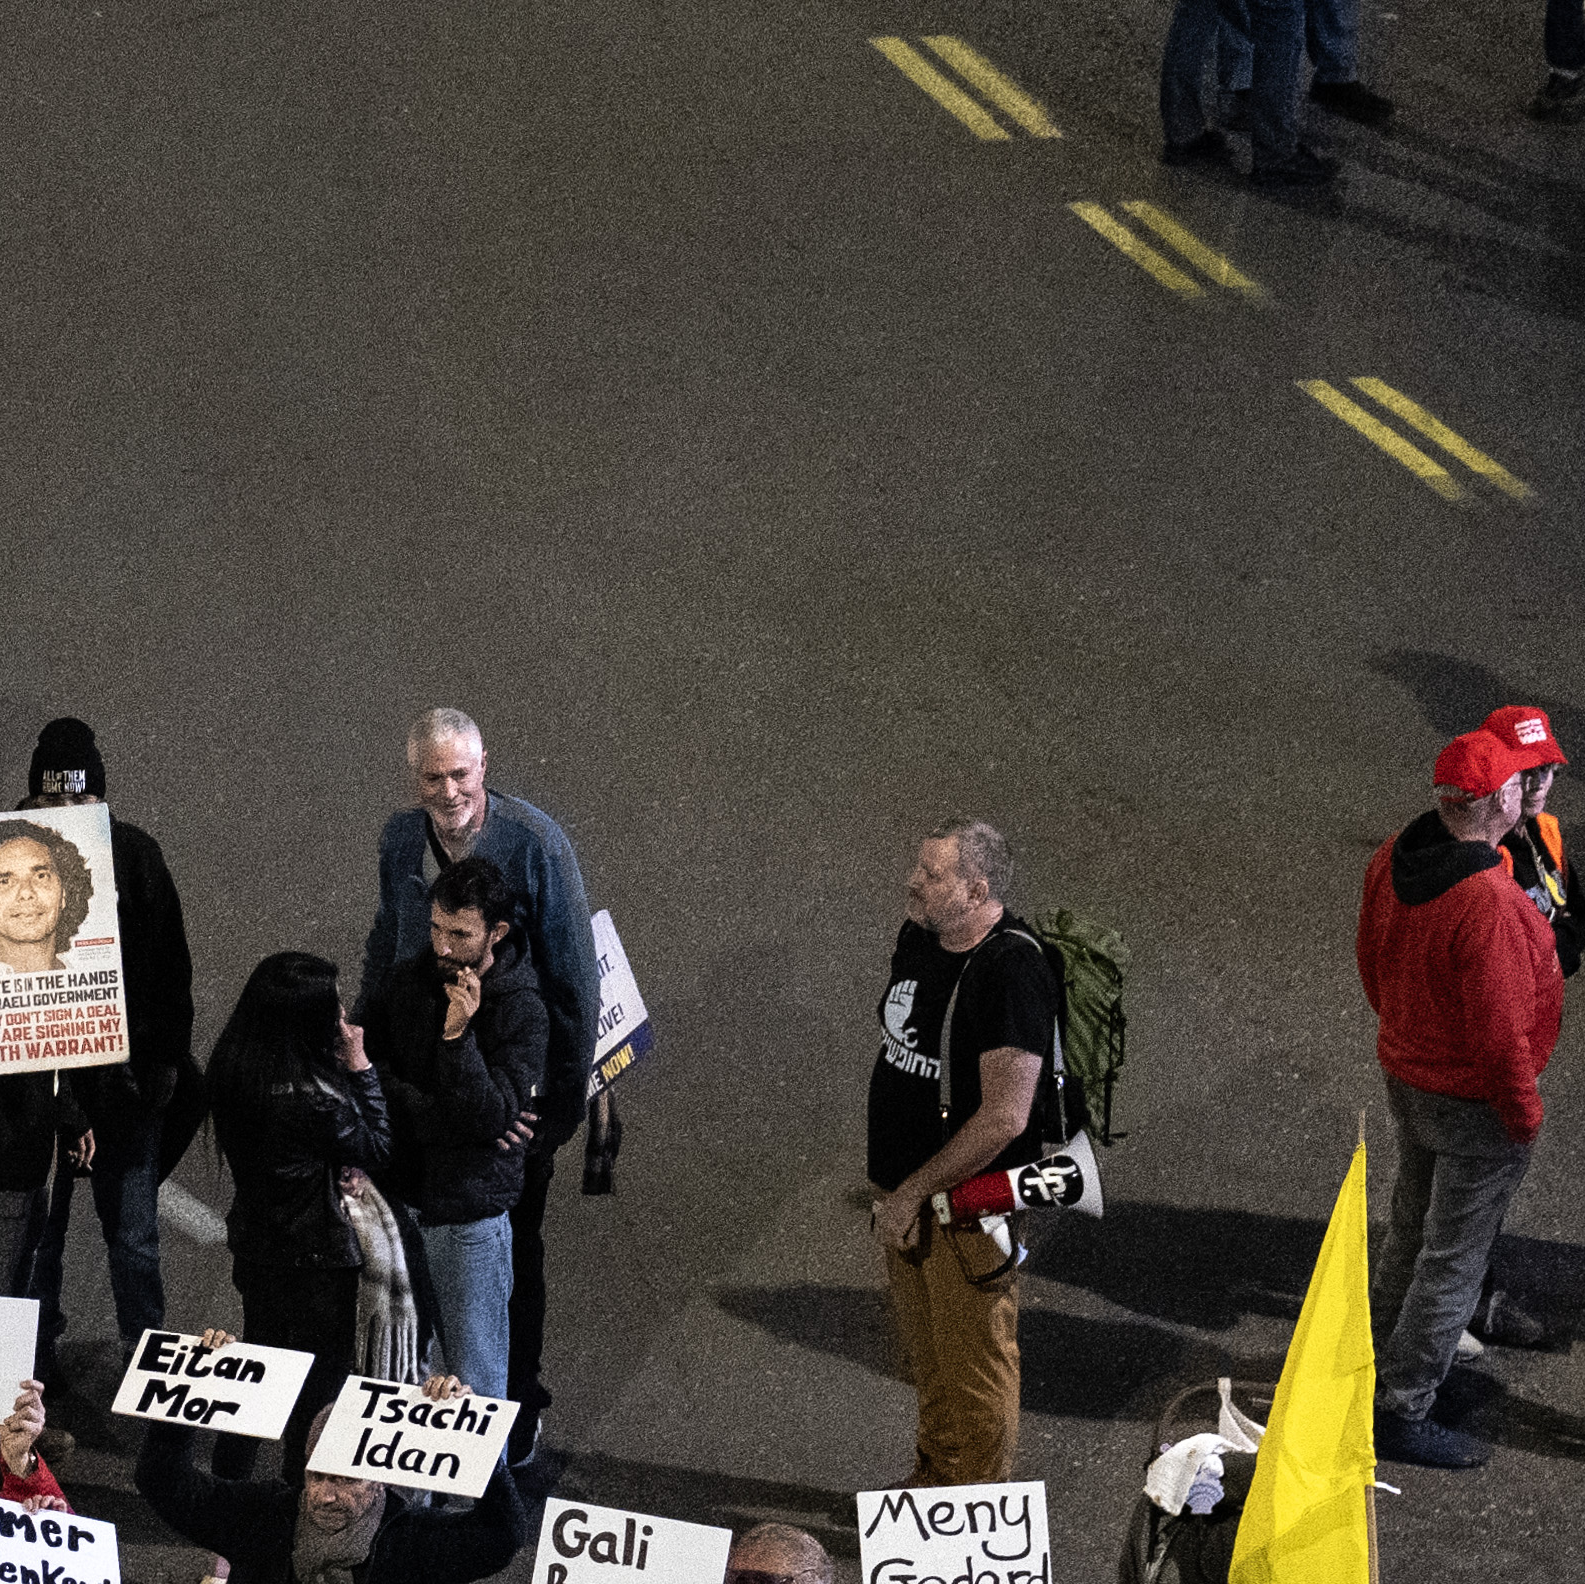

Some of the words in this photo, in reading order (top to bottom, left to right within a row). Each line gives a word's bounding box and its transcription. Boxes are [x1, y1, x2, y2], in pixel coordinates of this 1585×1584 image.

[63, 769, 86, 782] THEM
[33, 987, 119, 1006] GOVERNMENT
[36, 974, 65, 990] THE
[68, 970, 119, 987] HANDS
[2, 1026, 32, 1043] ARE
[36, 1022, 97, 1040] SIGNING
[99, 1018, 121, 1034] MY
[5, 1011, 41, 1026] DON'T
[44, 1007, 72, 1022] SIGN
[75, 1006, 85, 1019] A
[88, 1004, 121, 1018] DEAL
[25, 1034, 124, 1060] WARRANT!
[601, 1042, 636, 1082] NOW!
[138, 1333, 266, 1384] Eitan
[136, 1380, 241, 1426] Mor
[359, 1381, 499, 1436] Tsachi
[352, 1428, 461, 1480] Idan
[551, 1509, 654, 1571] Gali
[865, 1491, 1030, 1561] Meny
